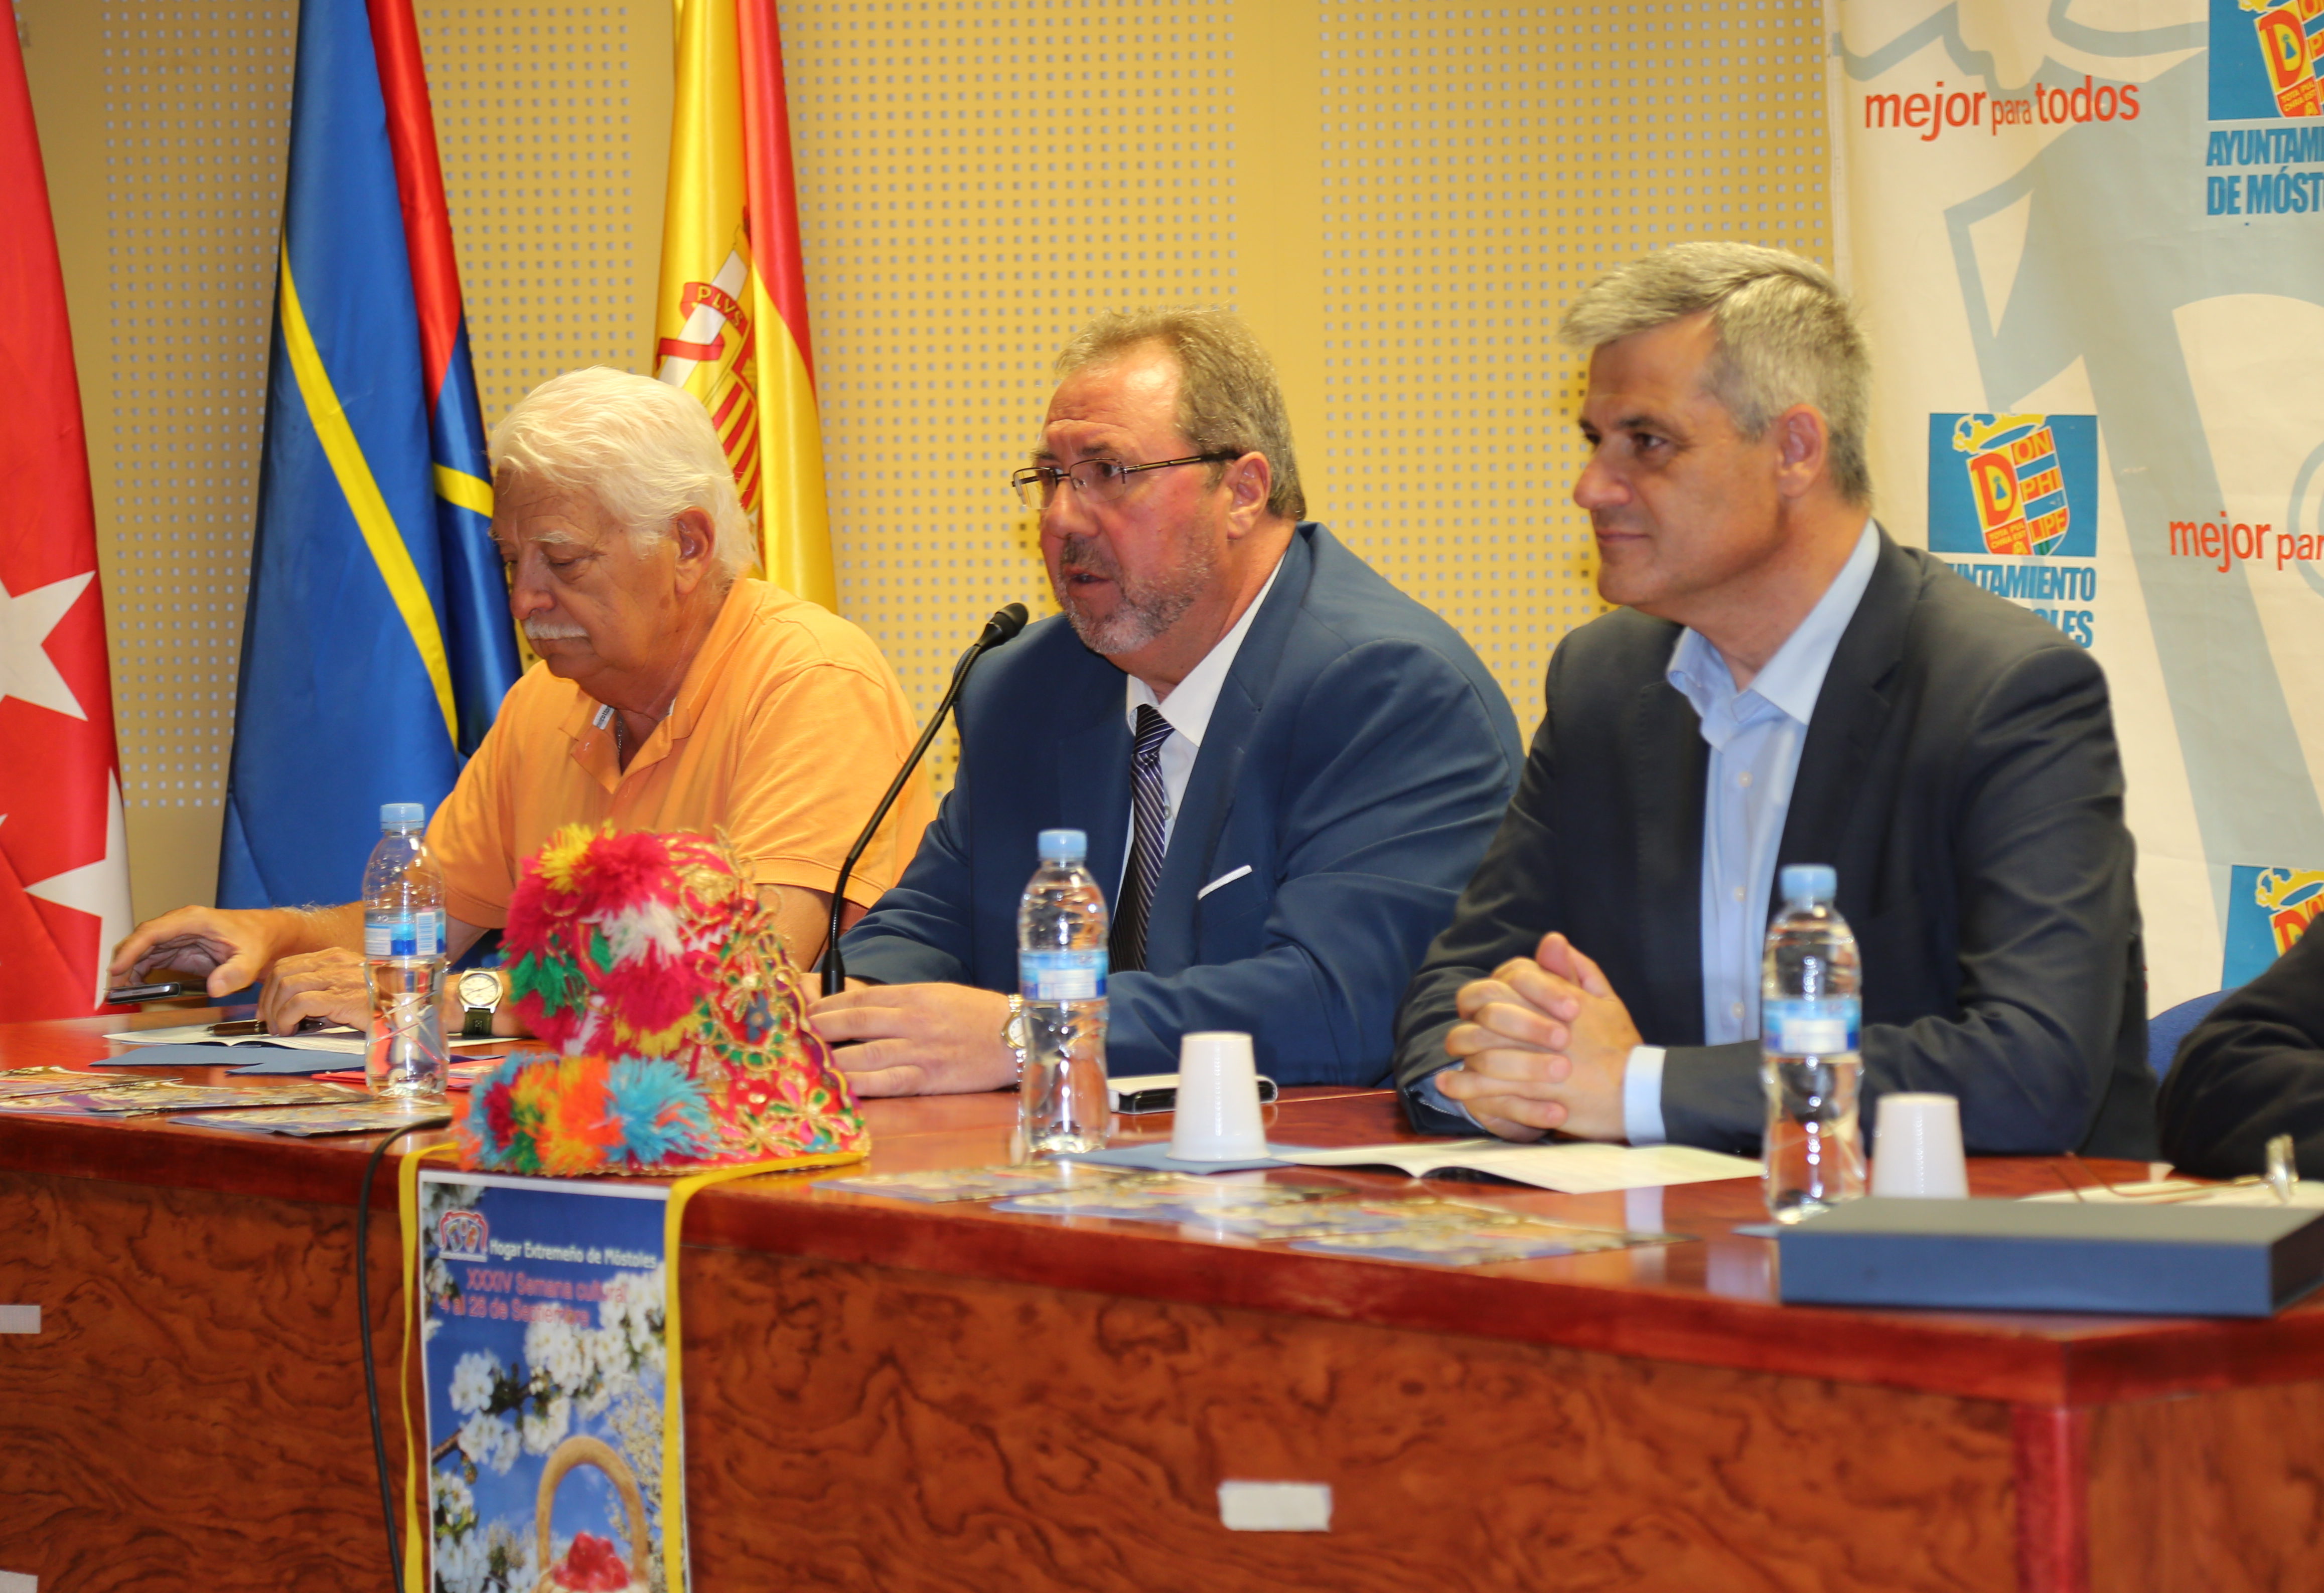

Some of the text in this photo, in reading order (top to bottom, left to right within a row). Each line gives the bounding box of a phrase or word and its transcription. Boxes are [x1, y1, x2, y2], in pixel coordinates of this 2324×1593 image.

[1865, 75, 2140, 142] mejor para todos
[2208, 176, 2241, 215] DE
[697, 284, 743, 328] PLVS
[2169, 511, 2324, 573] mejor par
[1946, 563, 2096, 601] NTAMIENTO
[489, 1239, 523, 1261] Hogar
[524, 1240, 585, 1263] Extremeño
[586, 1247, 602, 1264] de
[604, 1249, 657, 1269] Móstoles
[467, 1268, 513, 1293] XXXIV
[515, 1271, 573, 1300] Semana
[489, 1297, 509, 1320] de
[511, 1298, 590, 1328] Septiembre
